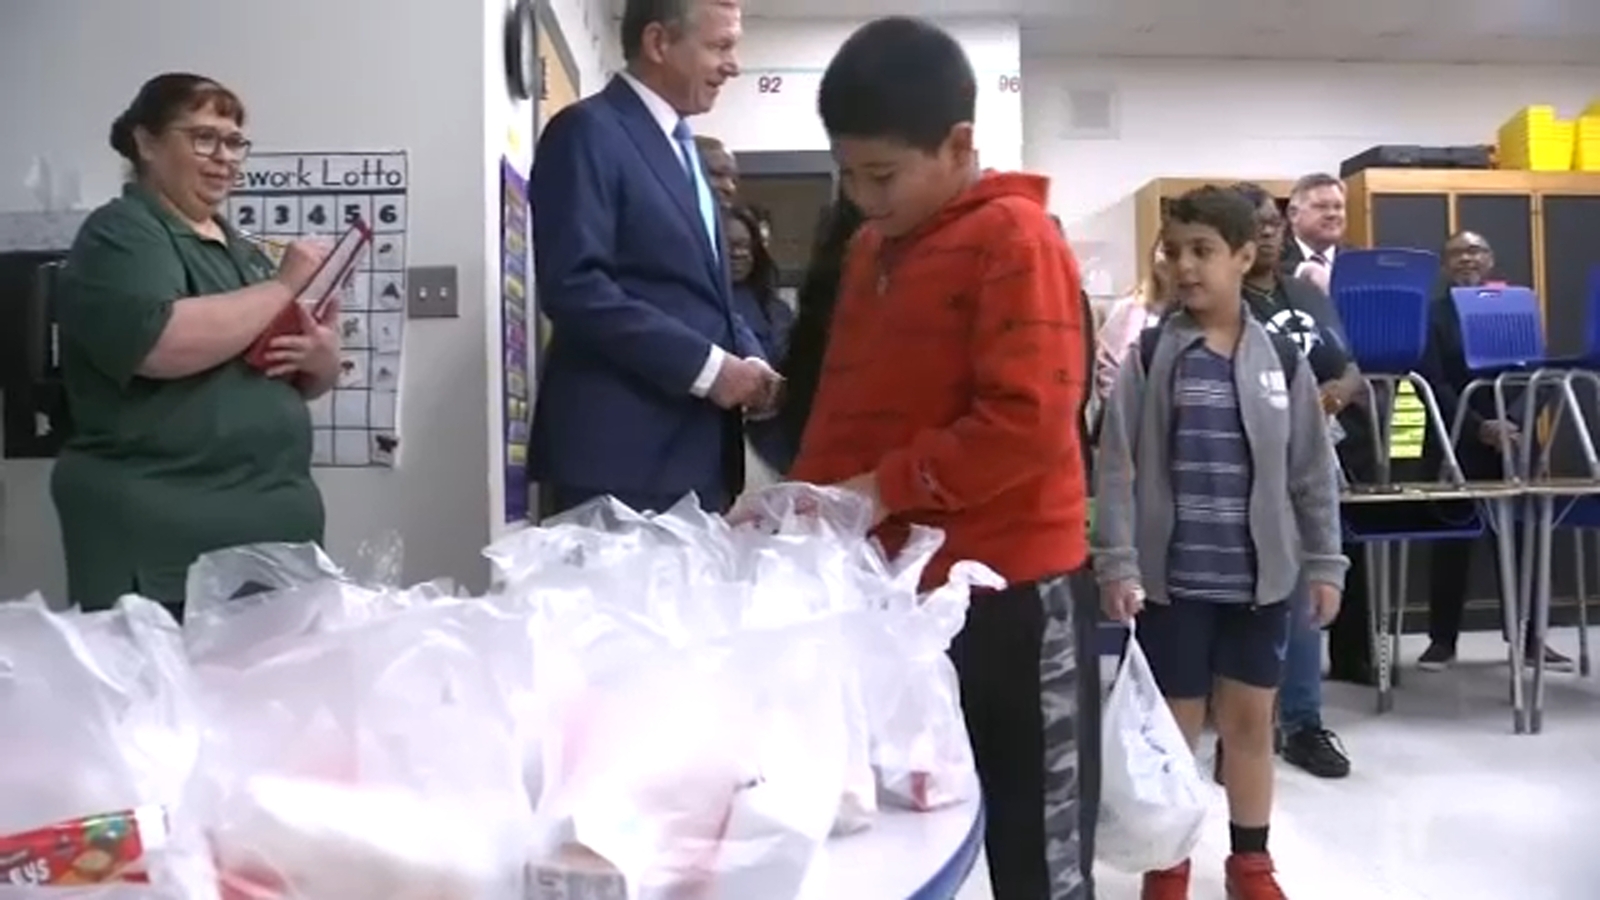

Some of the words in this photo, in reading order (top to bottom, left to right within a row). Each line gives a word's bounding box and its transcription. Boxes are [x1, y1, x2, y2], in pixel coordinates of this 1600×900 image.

[758, 77, 782, 93] 92
[998, 75, 1021, 93] 96
[322, 158, 402, 186] Lotto
[239, 205, 256, 225] 2
[275, 205, 290, 225] 3
[307, 204, 326, 226] 4
[344, 204, 361, 224] 5
[379, 204, 397, 224] 6
